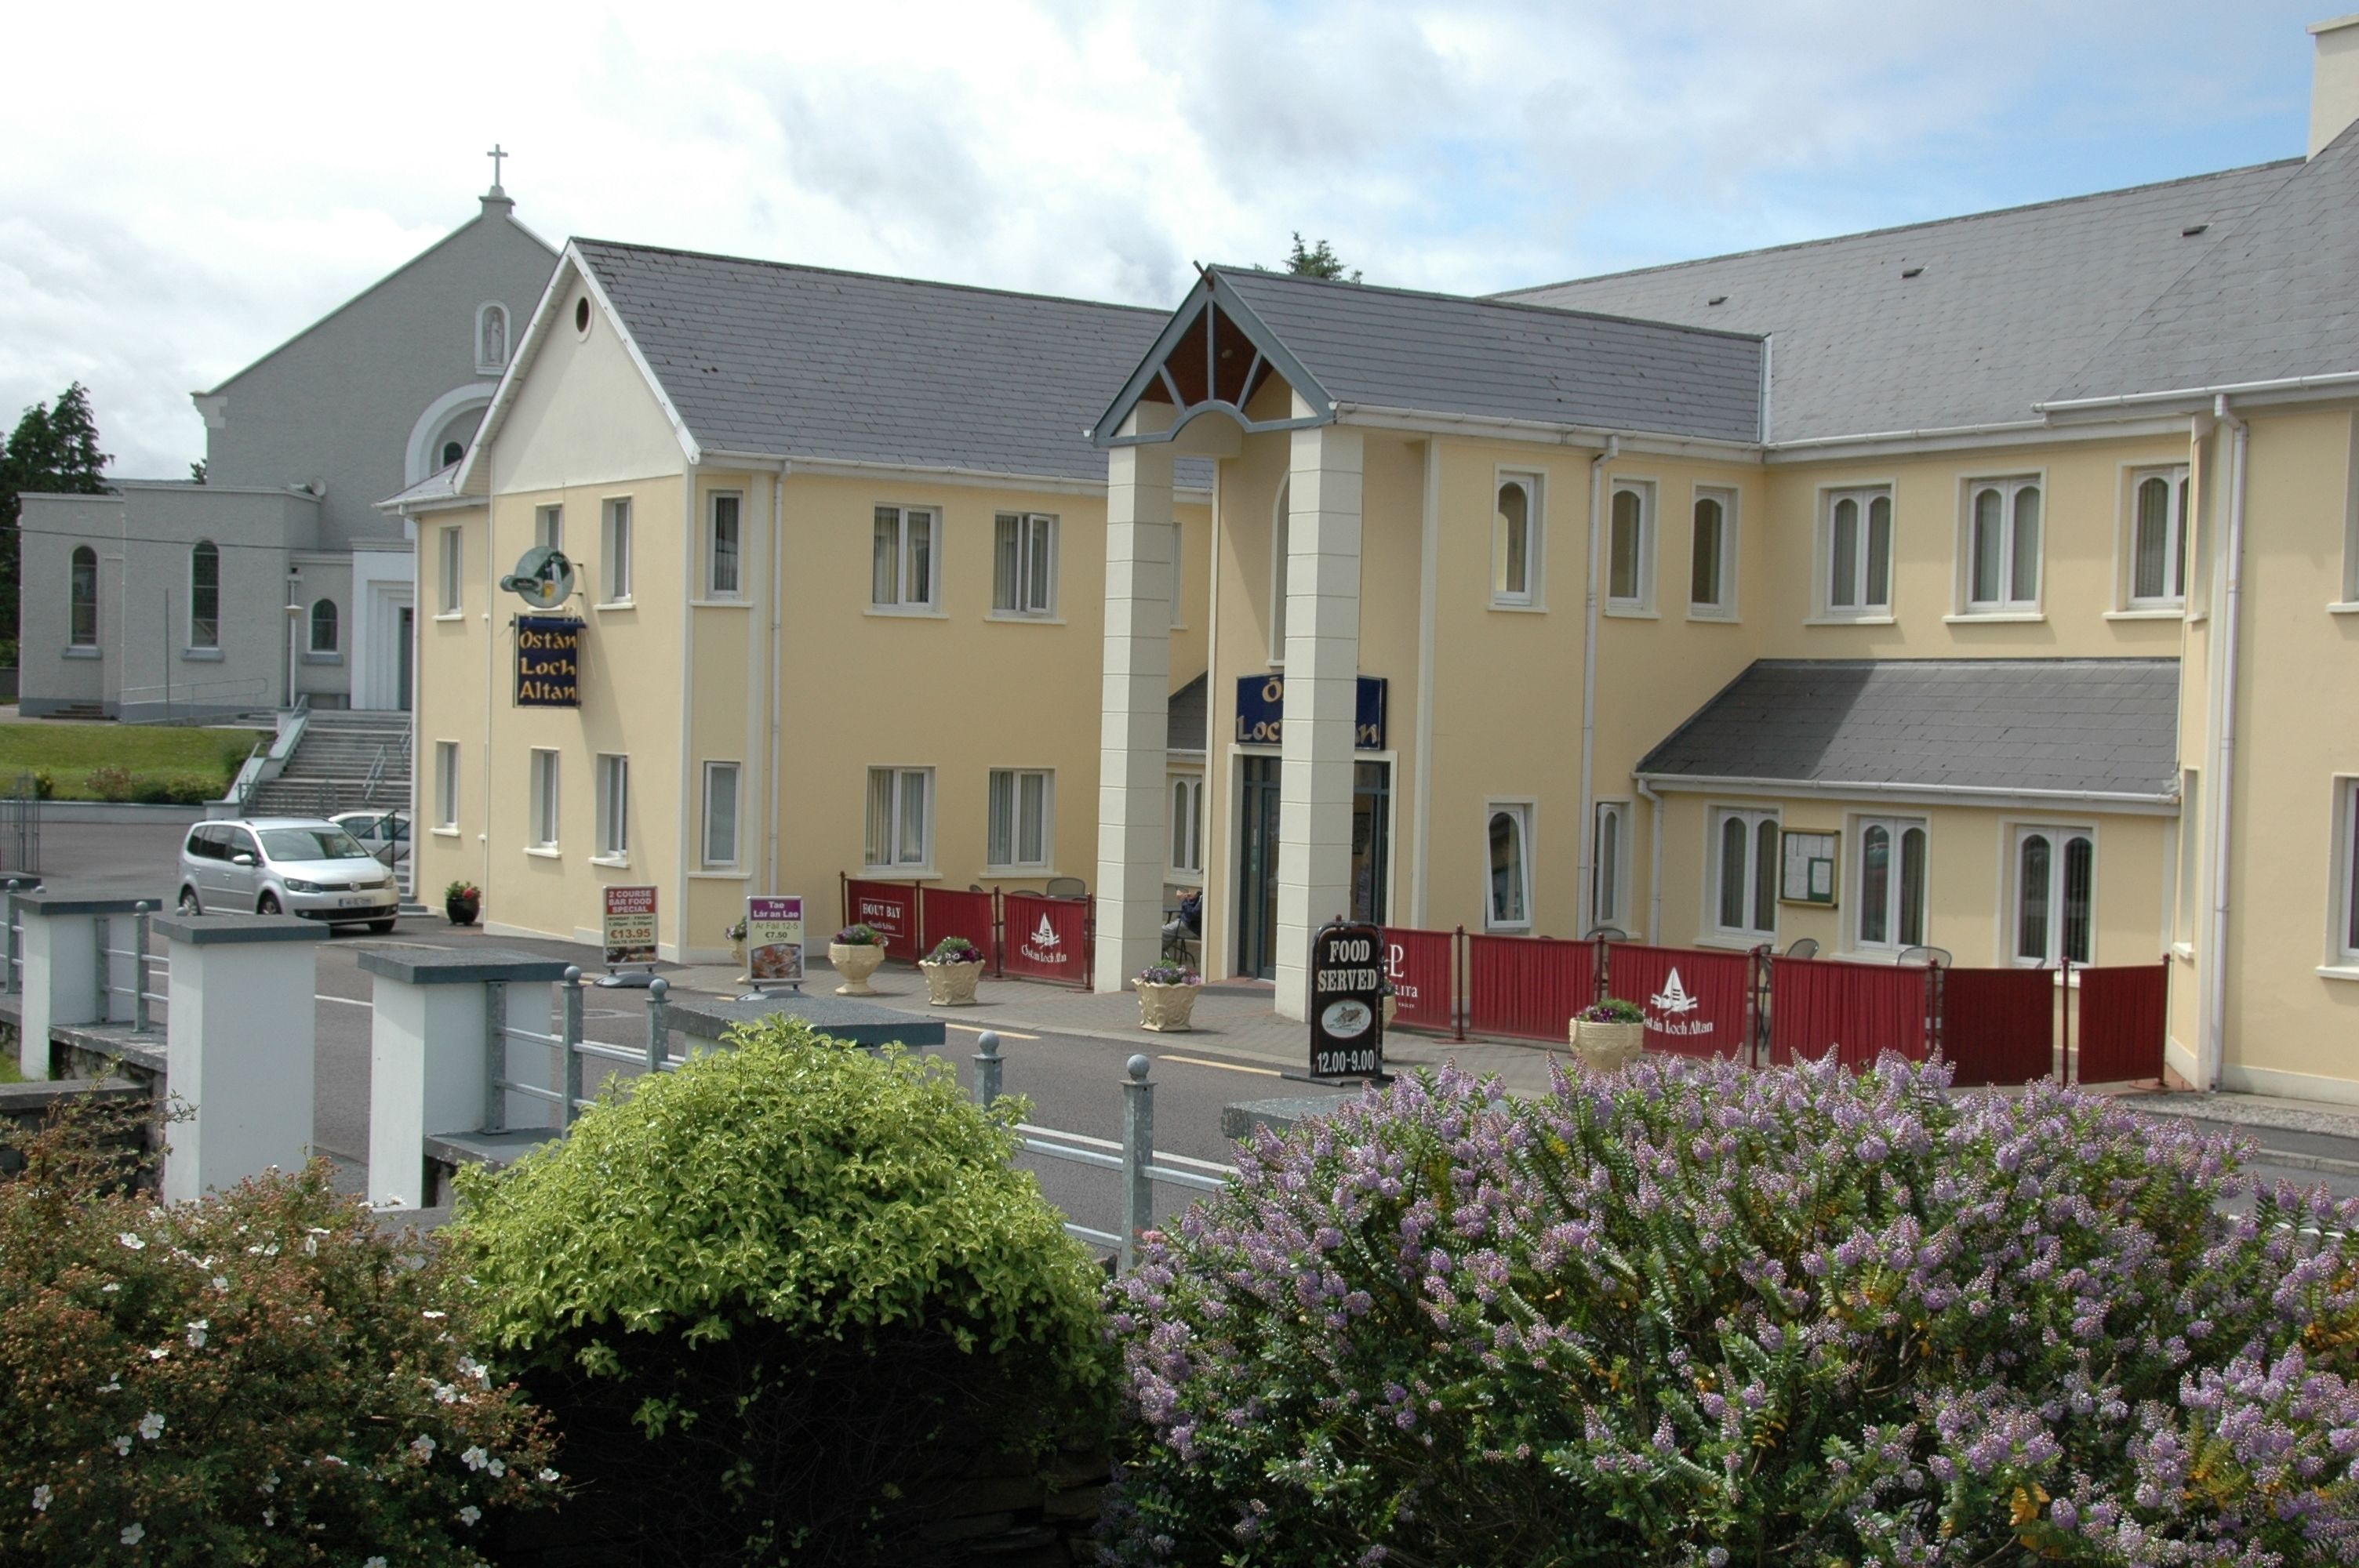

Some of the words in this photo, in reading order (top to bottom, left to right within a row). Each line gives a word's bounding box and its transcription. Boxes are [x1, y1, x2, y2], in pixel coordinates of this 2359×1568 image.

[520, 657, 576, 675] Loch
[519, 681, 576, 699] Altan
[1236, 715, 1282, 742] Loc
[612, 905, 649, 913] SPECIAL
[886, 906, 901, 918] BAY
[610, 928, 651, 938] €13.95
[1329, 940, 1370, 963] FOOD
[1318, 969, 1377, 992] SERVED
[1643, 1010, 1663, 1032] stán
[1665, 1019, 1688, 1035] Loch
[1688, 1019, 1713, 1035] Altan
[1318, 1049, 1375, 1073] 12.00-9.00
